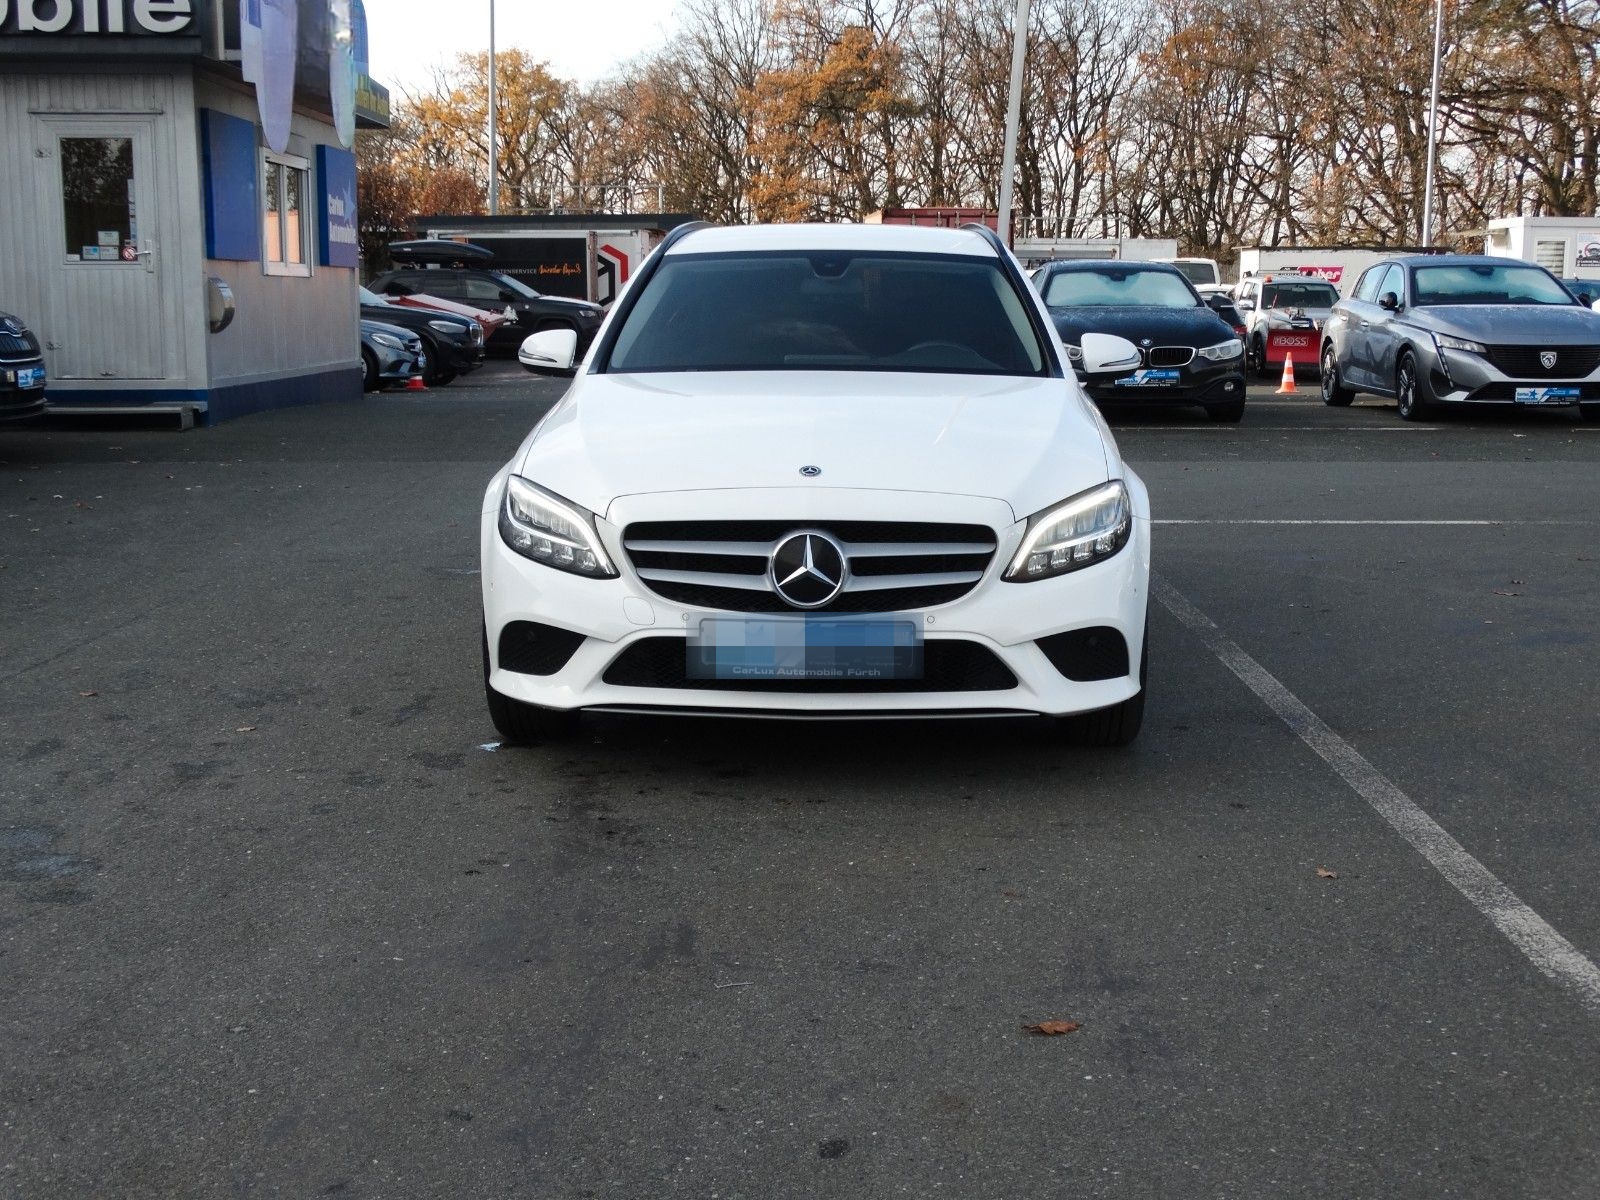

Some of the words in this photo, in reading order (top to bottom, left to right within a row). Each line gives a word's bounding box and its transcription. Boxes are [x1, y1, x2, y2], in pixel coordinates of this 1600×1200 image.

[0, 0, 192, 33] bile
[1280, 336, 1307, 347] BOSS
[732, 666, 774, 675] CarLux
[776, 667, 843, 676] Automobile
[847, 668, 881, 676] Fürth
